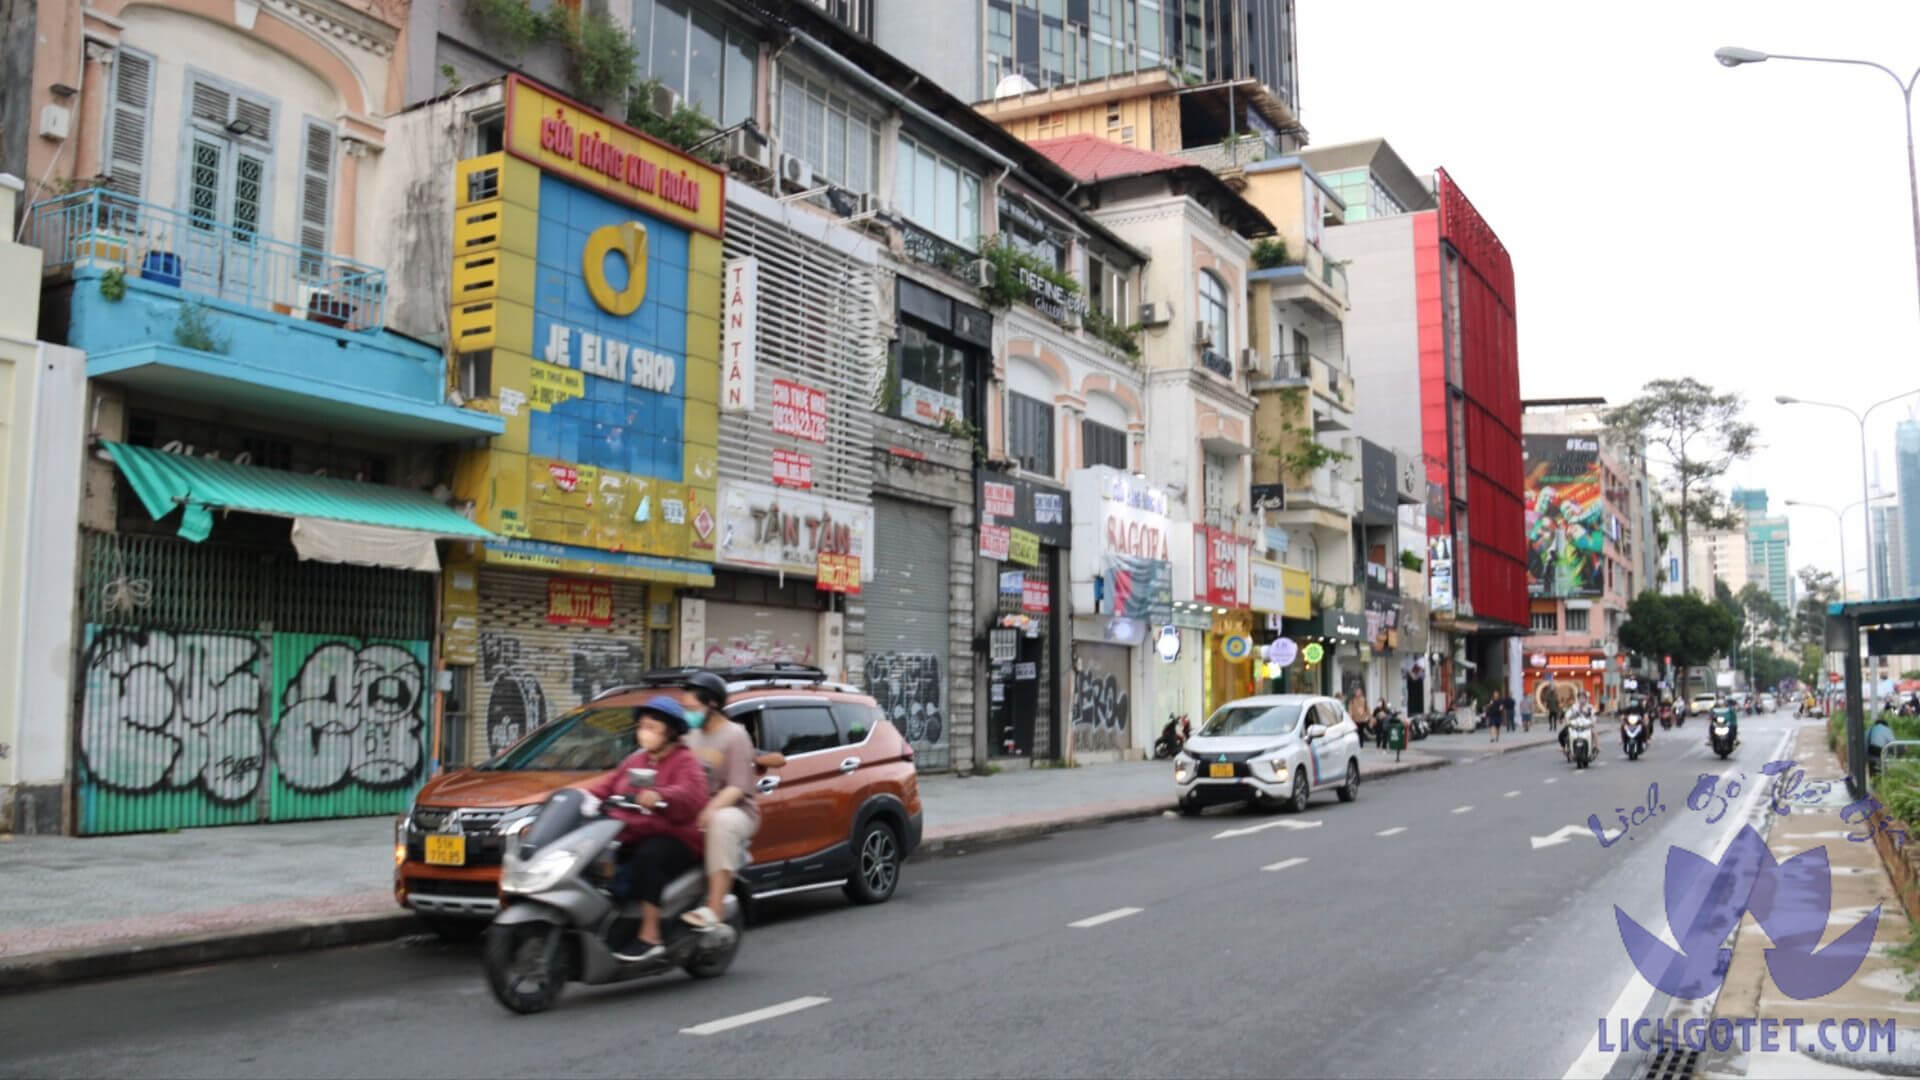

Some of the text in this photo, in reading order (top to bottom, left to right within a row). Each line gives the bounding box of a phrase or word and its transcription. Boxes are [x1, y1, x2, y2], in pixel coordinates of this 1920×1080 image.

[627, 154, 657, 195] KIM
[631, 348, 676, 393] SHOP
[750, 500, 851, 554] TÂN TÂN
